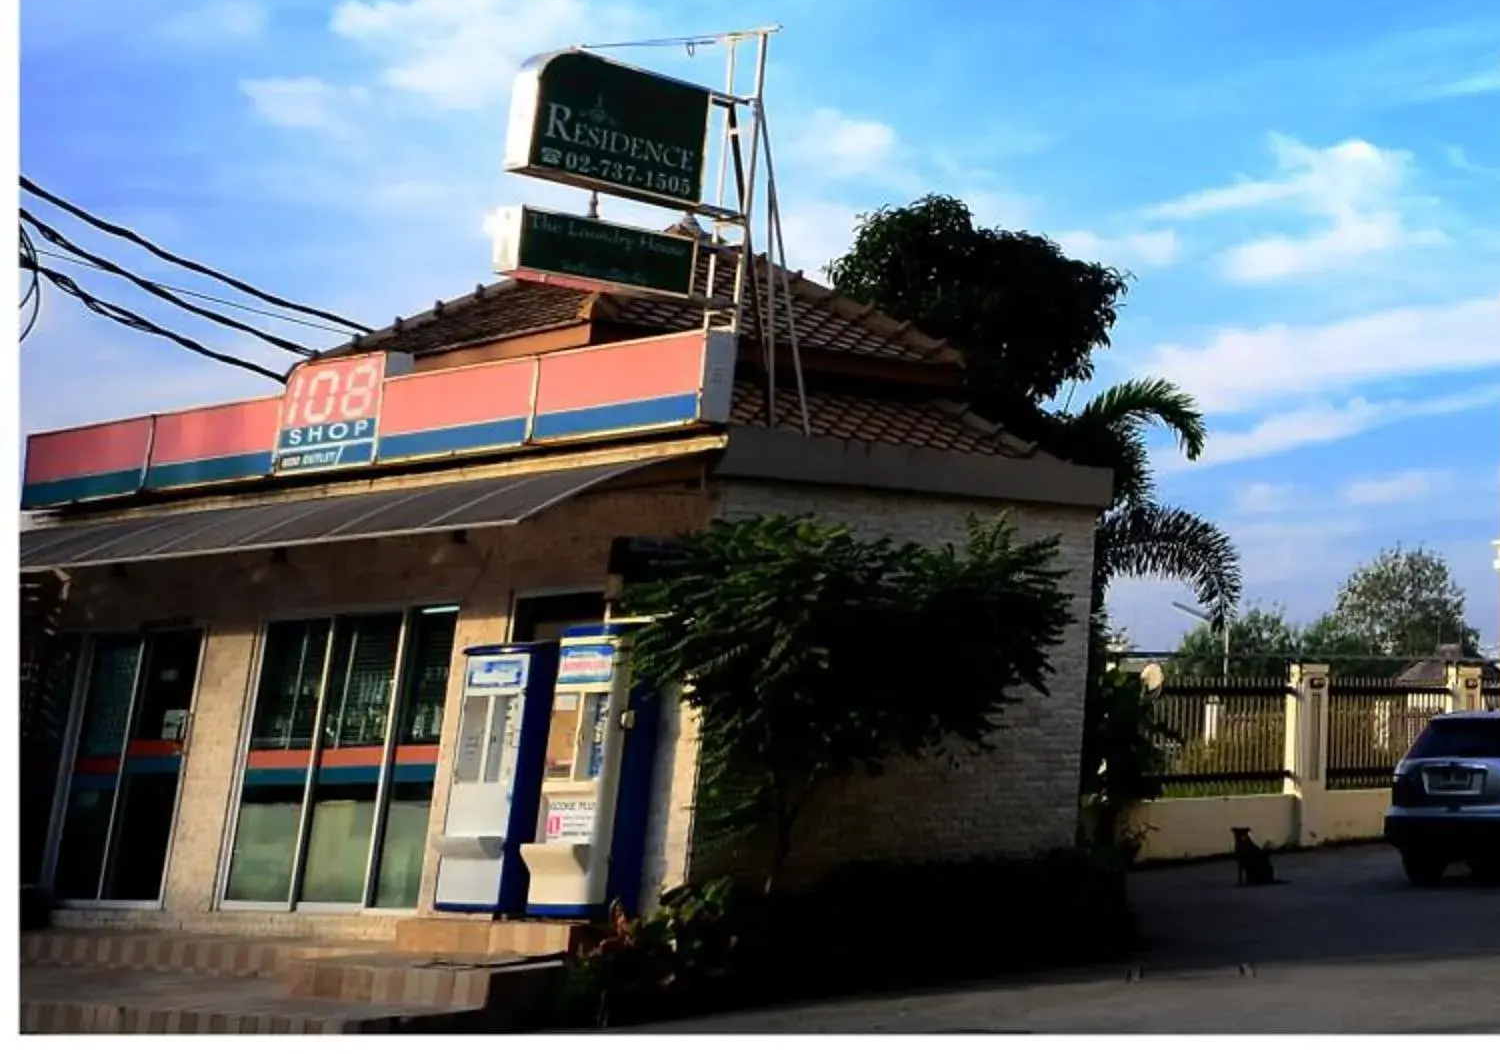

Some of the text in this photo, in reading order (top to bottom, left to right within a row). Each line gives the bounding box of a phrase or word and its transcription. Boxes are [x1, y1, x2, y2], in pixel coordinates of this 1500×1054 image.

[545, 102, 693, 171] RESIDENCE
[566, 152, 691, 195] 02-737-1505
[288, 365, 376, 423] 108
[288, 419, 369, 445] SHOP
